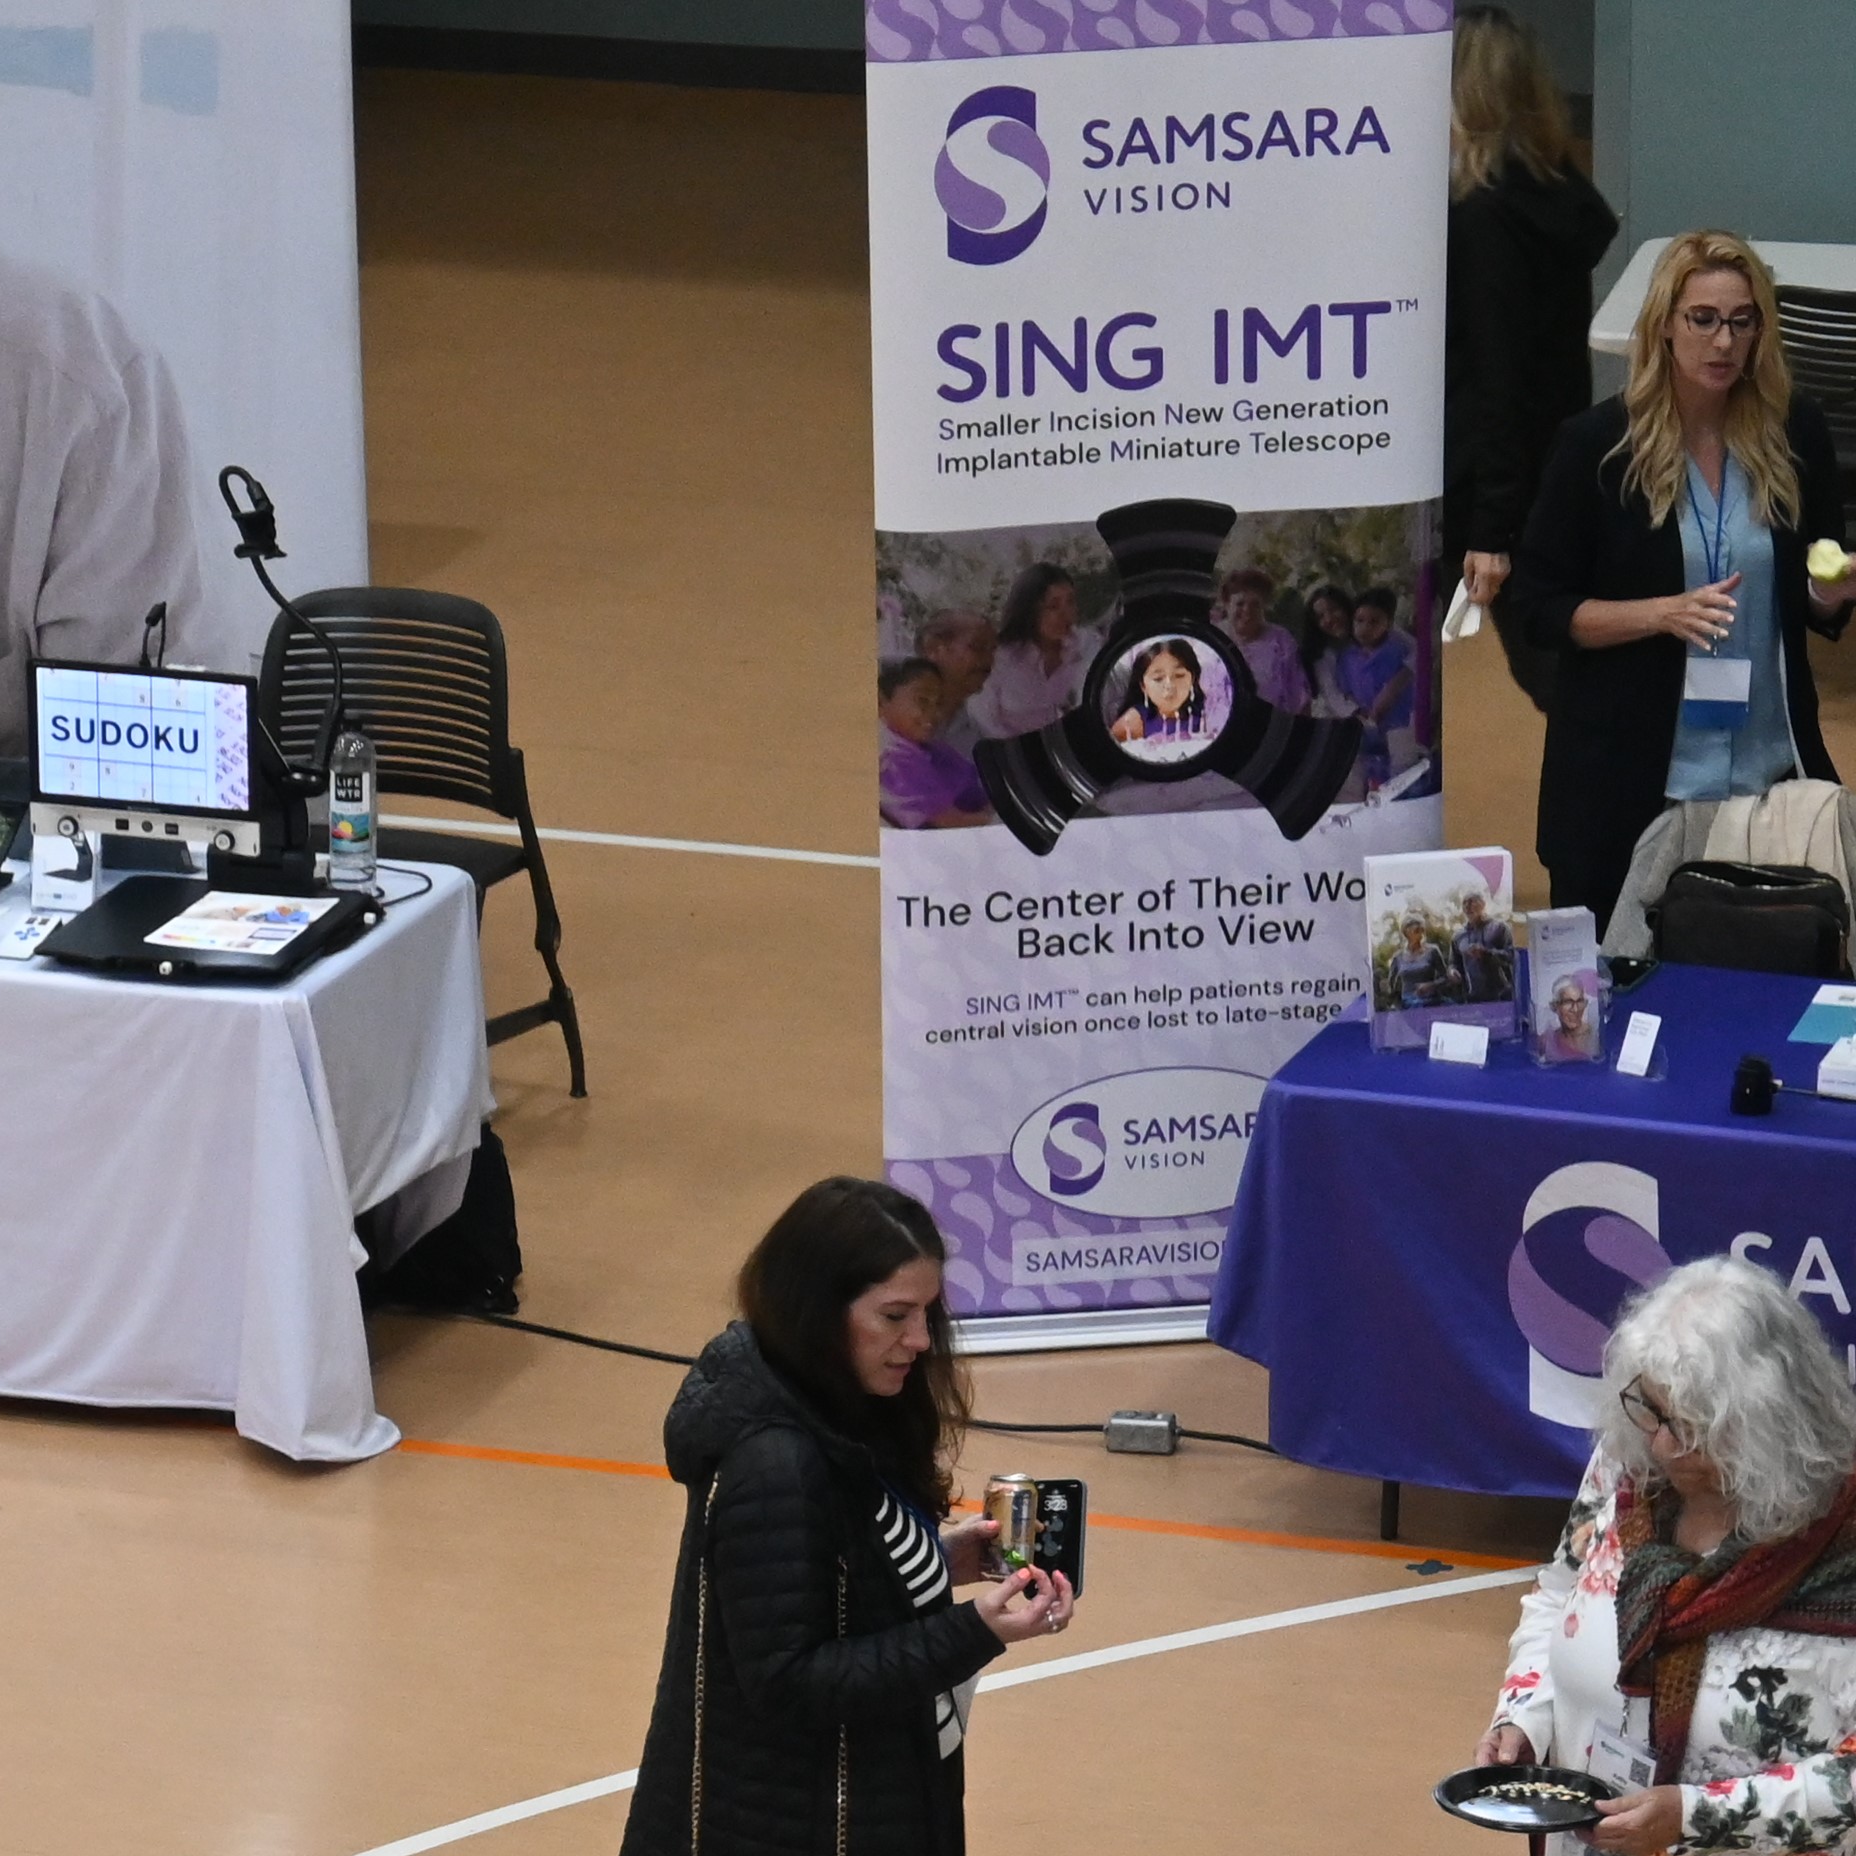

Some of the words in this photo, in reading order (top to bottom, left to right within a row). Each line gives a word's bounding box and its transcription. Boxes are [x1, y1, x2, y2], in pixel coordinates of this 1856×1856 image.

[1081, 105, 1391, 169] SAMSARA
[1083, 181, 1232, 216] VISION
[936, 311, 1164, 403] SING
[939, 414, 1041, 441] Smaller
[1049, 406, 1155, 434] Incision
[1164, 403, 1224, 425] New
[1233, 395, 1389, 422] Generation
[937, 441, 1101, 479] Implantable
[1109, 436, 1241, 463] Miniature
[1249, 429, 1391, 462] Telescope
[51, 715, 199, 754] SUDOKU
[336, 777, 360, 788] LIFE
[337, 788, 361, 799] WTR
[897, 895, 971, 929] The
[984, 887, 1124, 924] Center
[1136, 879, 1175, 914] of
[1189, 873, 1291, 911] Their
[1016, 923, 1114, 959] Back
[1127, 921, 1204, 953] Into
[1219, 914, 1315, 948] View
[966, 995, 1021, 1016] SING
[1086, 991, 1127, 1009] can
[1133, 986, 1183, 1008] help
[1189, 978, 1284, 1006] patients
[1291, 975, 1361, 1000] regain
[925, 1021, 1006, 1045] central
[1011, 1016, 1077, 1039] vision
[1084, 1016, 1141, 1033] once
[1147, 1010, 1189, 1030] lost
[1195, 1009, 1219, 1026] to
[1225, 1000, 1343, 1026] late-stage
[1123, 1111, 1257, 1146] SAMSAR
[1124, 1150, 1206, 1170] VISION
